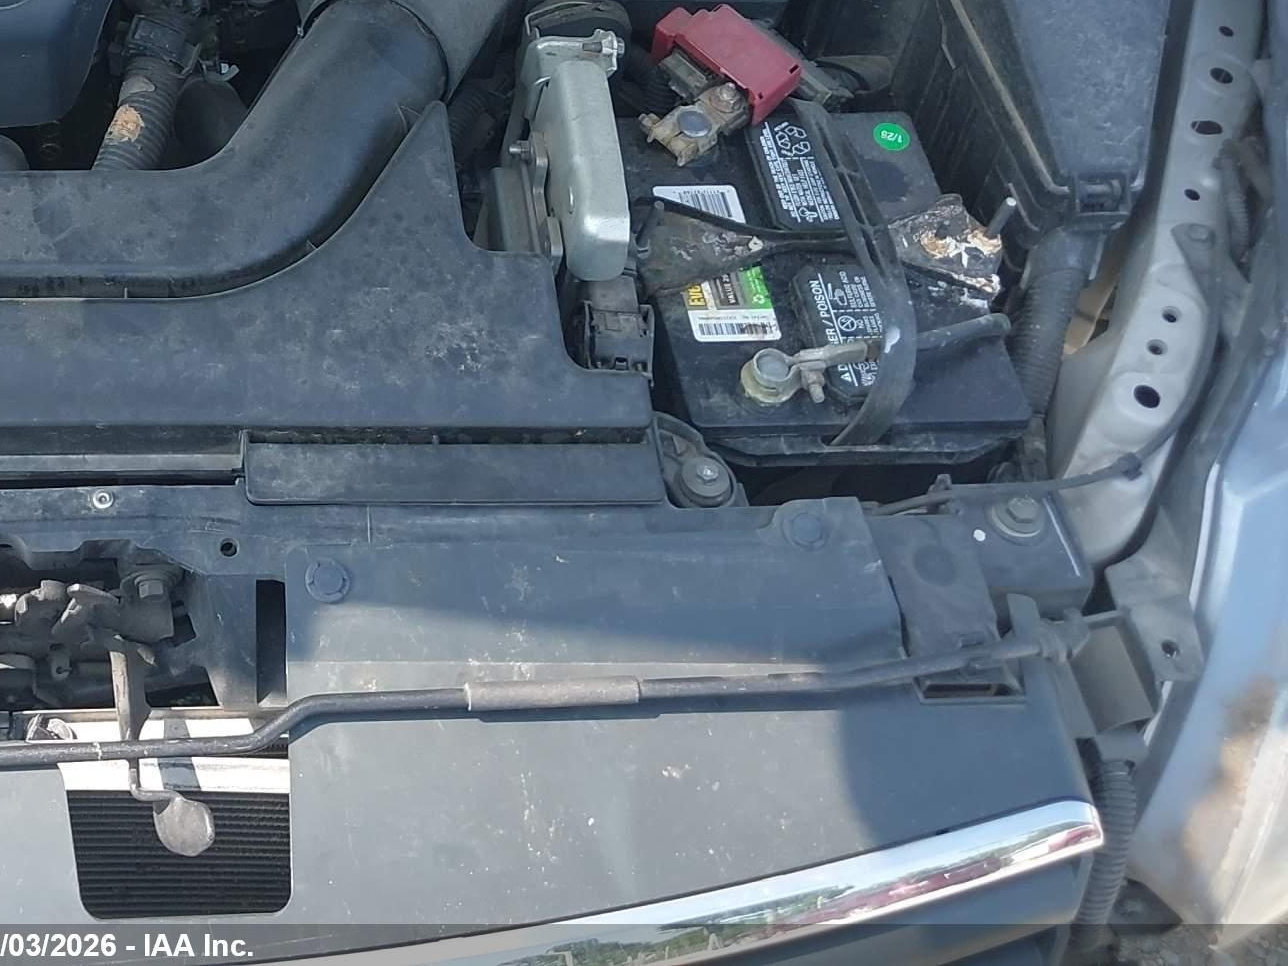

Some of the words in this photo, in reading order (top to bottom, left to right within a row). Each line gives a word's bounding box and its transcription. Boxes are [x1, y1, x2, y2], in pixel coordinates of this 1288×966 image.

[838, 271, 849, 283] ACID
[723, 283, 736, 304] VALUE
[808, 280, 830, 317] POISON
[843, 284, 857, 307] SULFURIC
[855, 318, 865, 328] NO
